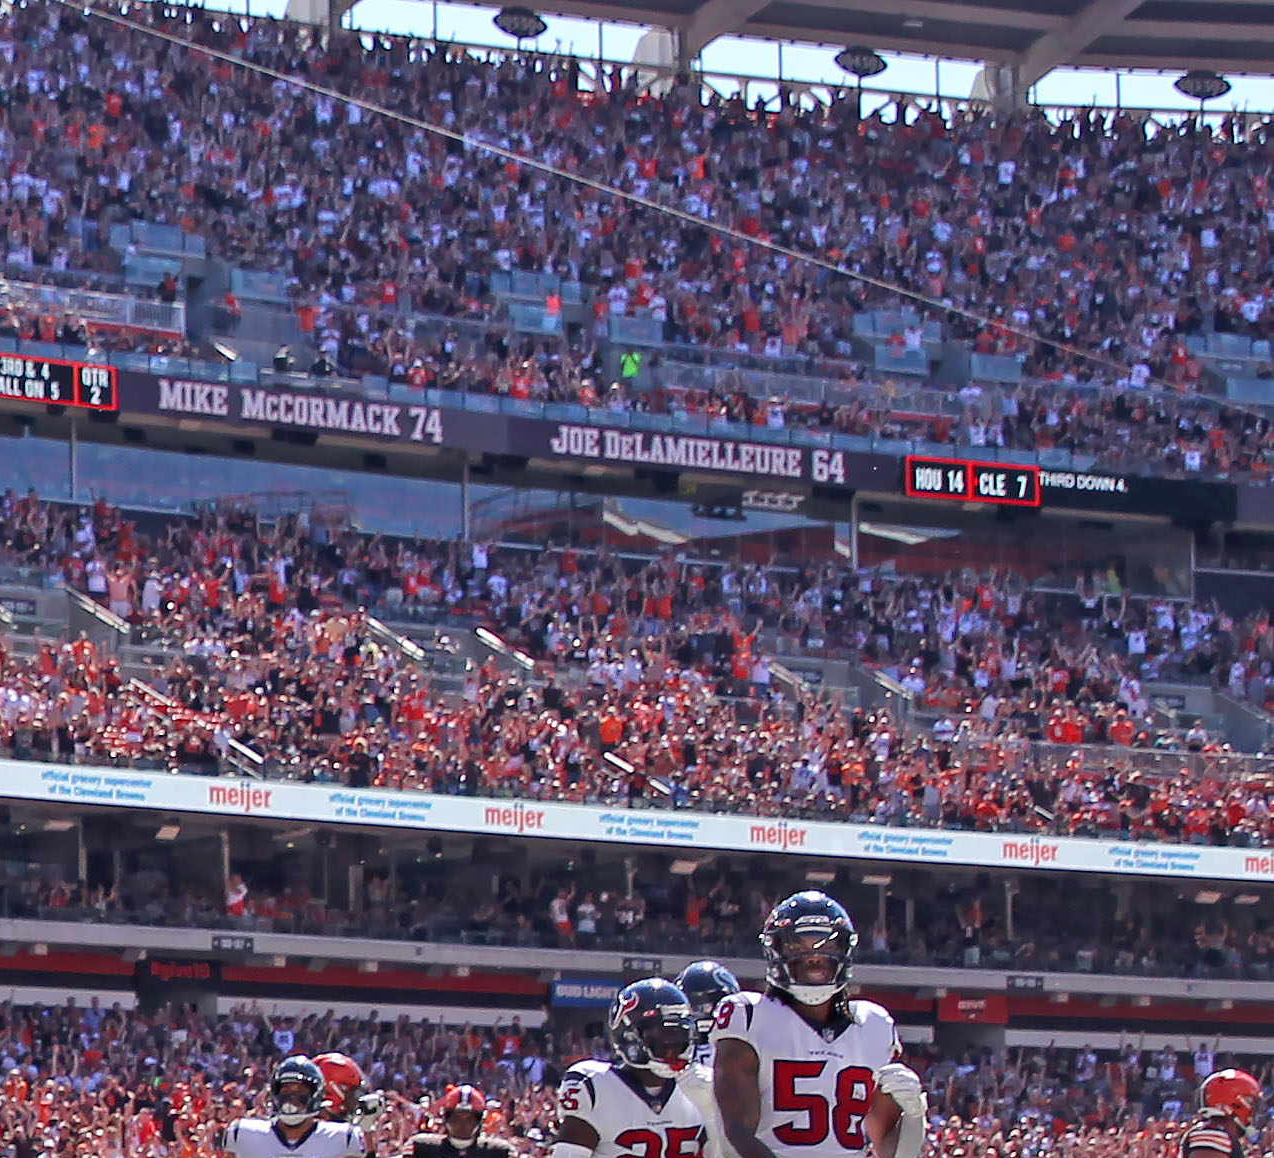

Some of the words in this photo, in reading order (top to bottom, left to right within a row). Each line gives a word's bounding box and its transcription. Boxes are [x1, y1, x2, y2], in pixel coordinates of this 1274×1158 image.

[0, 356, 23, 376] 3RD
[41, 363, 50, 380] 4
[82, 367, 109, 387] QTR
[25, 379, 45, 399] ON
[51, 381, 60, 400] 5
[91, 386, 101, 405] 2
[158, 378, 229, 416] MIKE
[409, 406, 444, 444] 74
[550, 424, 600, 458] JOE
[811, 450, 846, 485] 64
[915, 467, 942, 491] HOU
[948, 470, 964, 493] 14
[978, 473, 1006, 497] CLE
[1016, 475, 1027, 499] 7
[1039, 470, 1075, 489] THIRD
[1076, 474, 1115, 492] DOWN
[209, 782, 272, 812] meijer
[485, 804, 545, 833] meijer
[750, 822, 807, 850] meijer
[1003, 840, 1058, 866] meijer
[773, 1060, 874, 1150] 58
